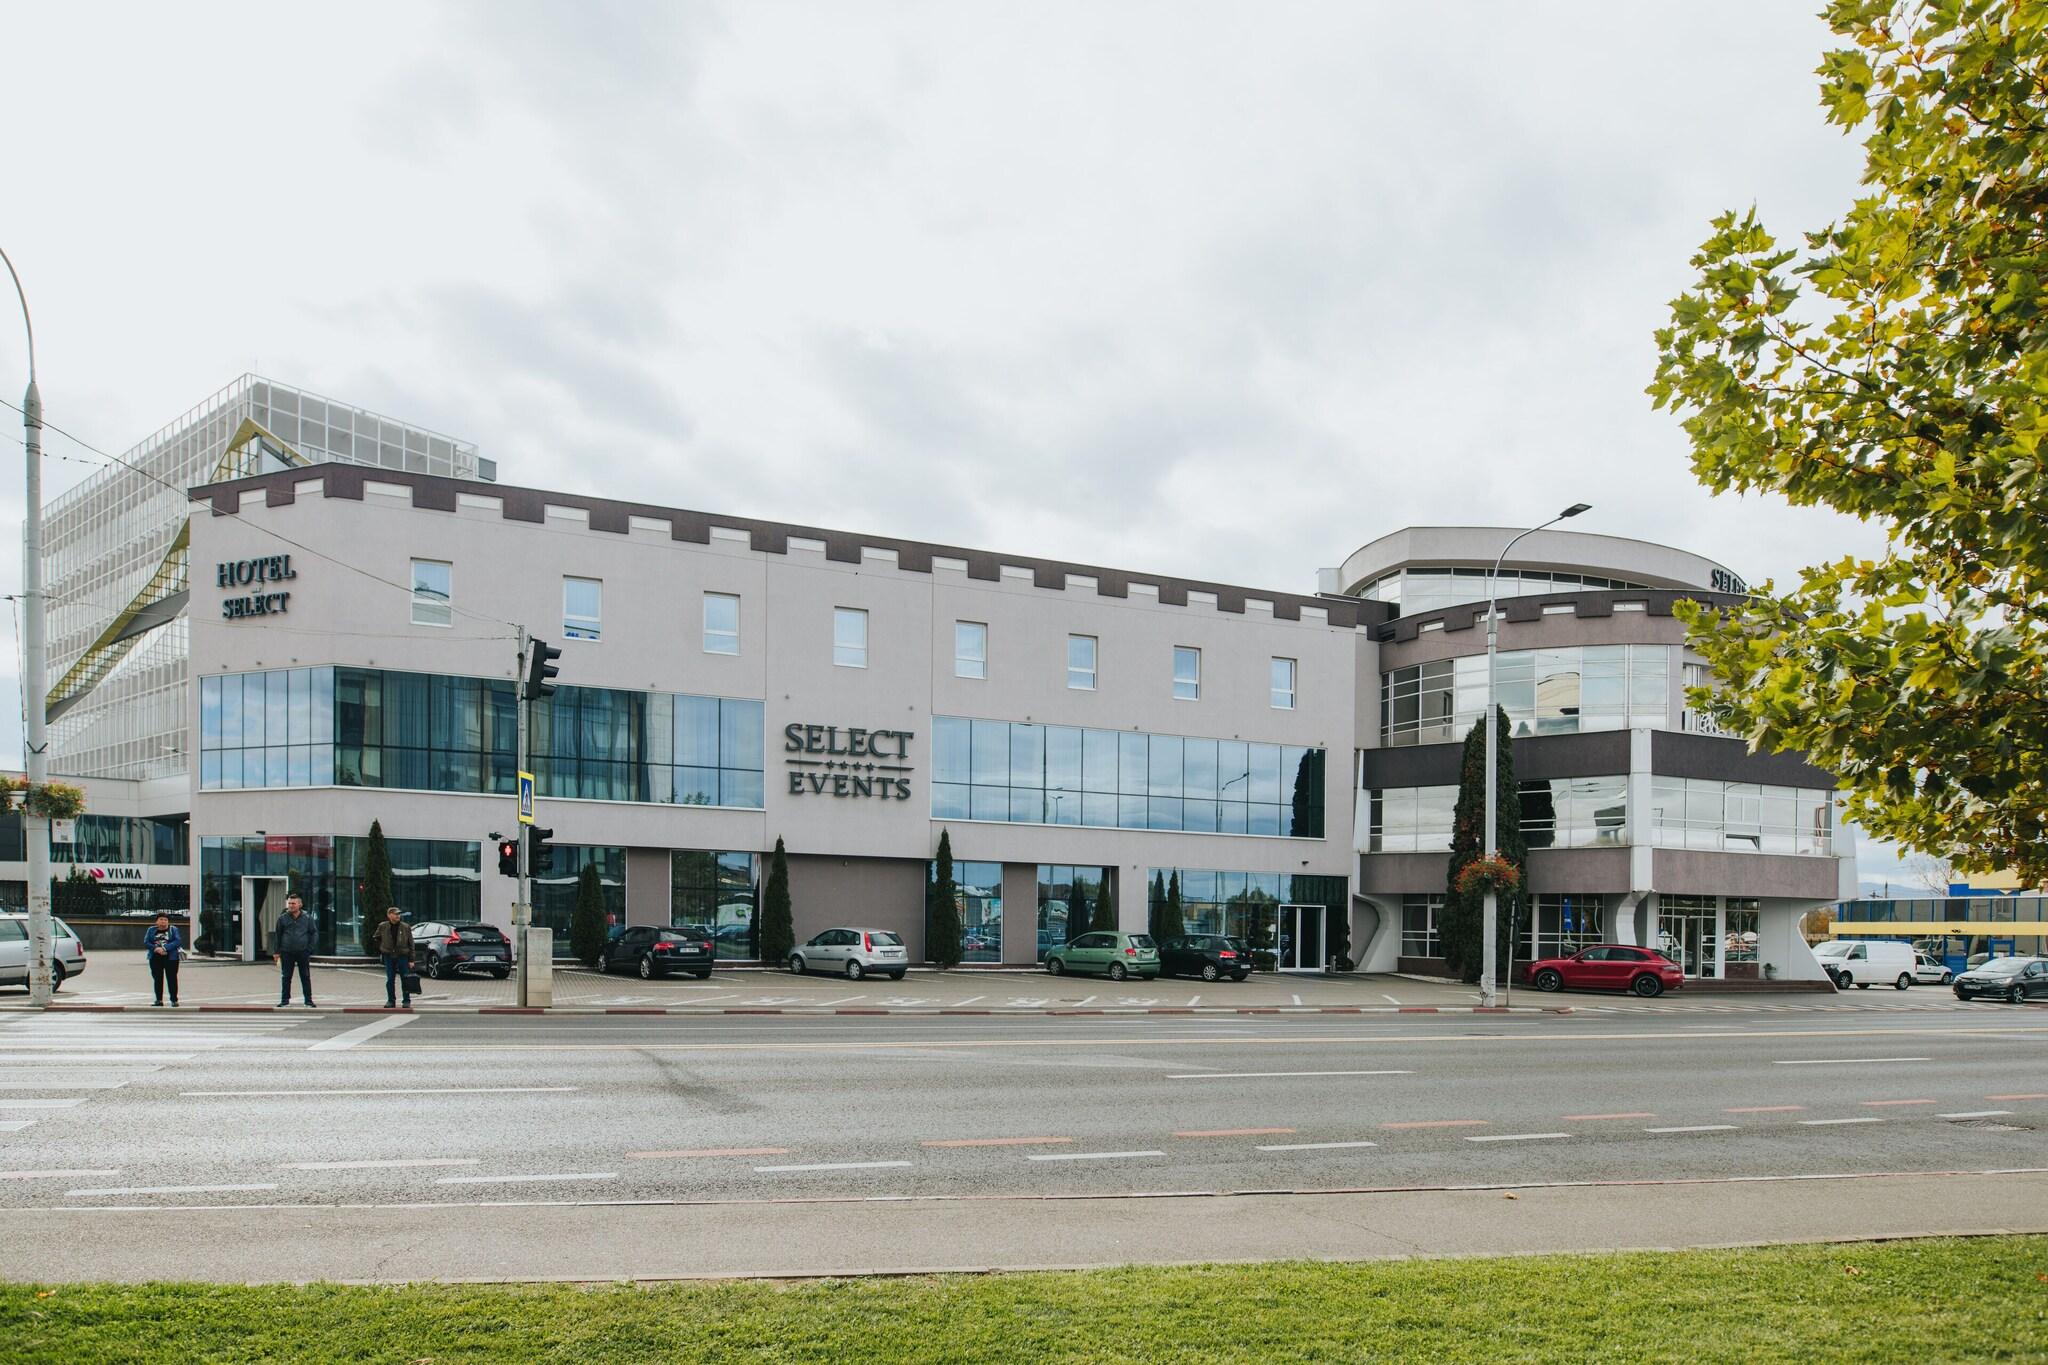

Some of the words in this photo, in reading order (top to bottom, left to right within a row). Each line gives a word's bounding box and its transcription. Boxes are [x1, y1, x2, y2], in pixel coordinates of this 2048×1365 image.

[216, 554, 297, 588] HOTEL
[222, 591, 290, 619] SELECT
[785, 723, 915, 759] SELECT
[789, 771, 911, 800] EVENTS
[107, 867, 142, 880] VISMA
